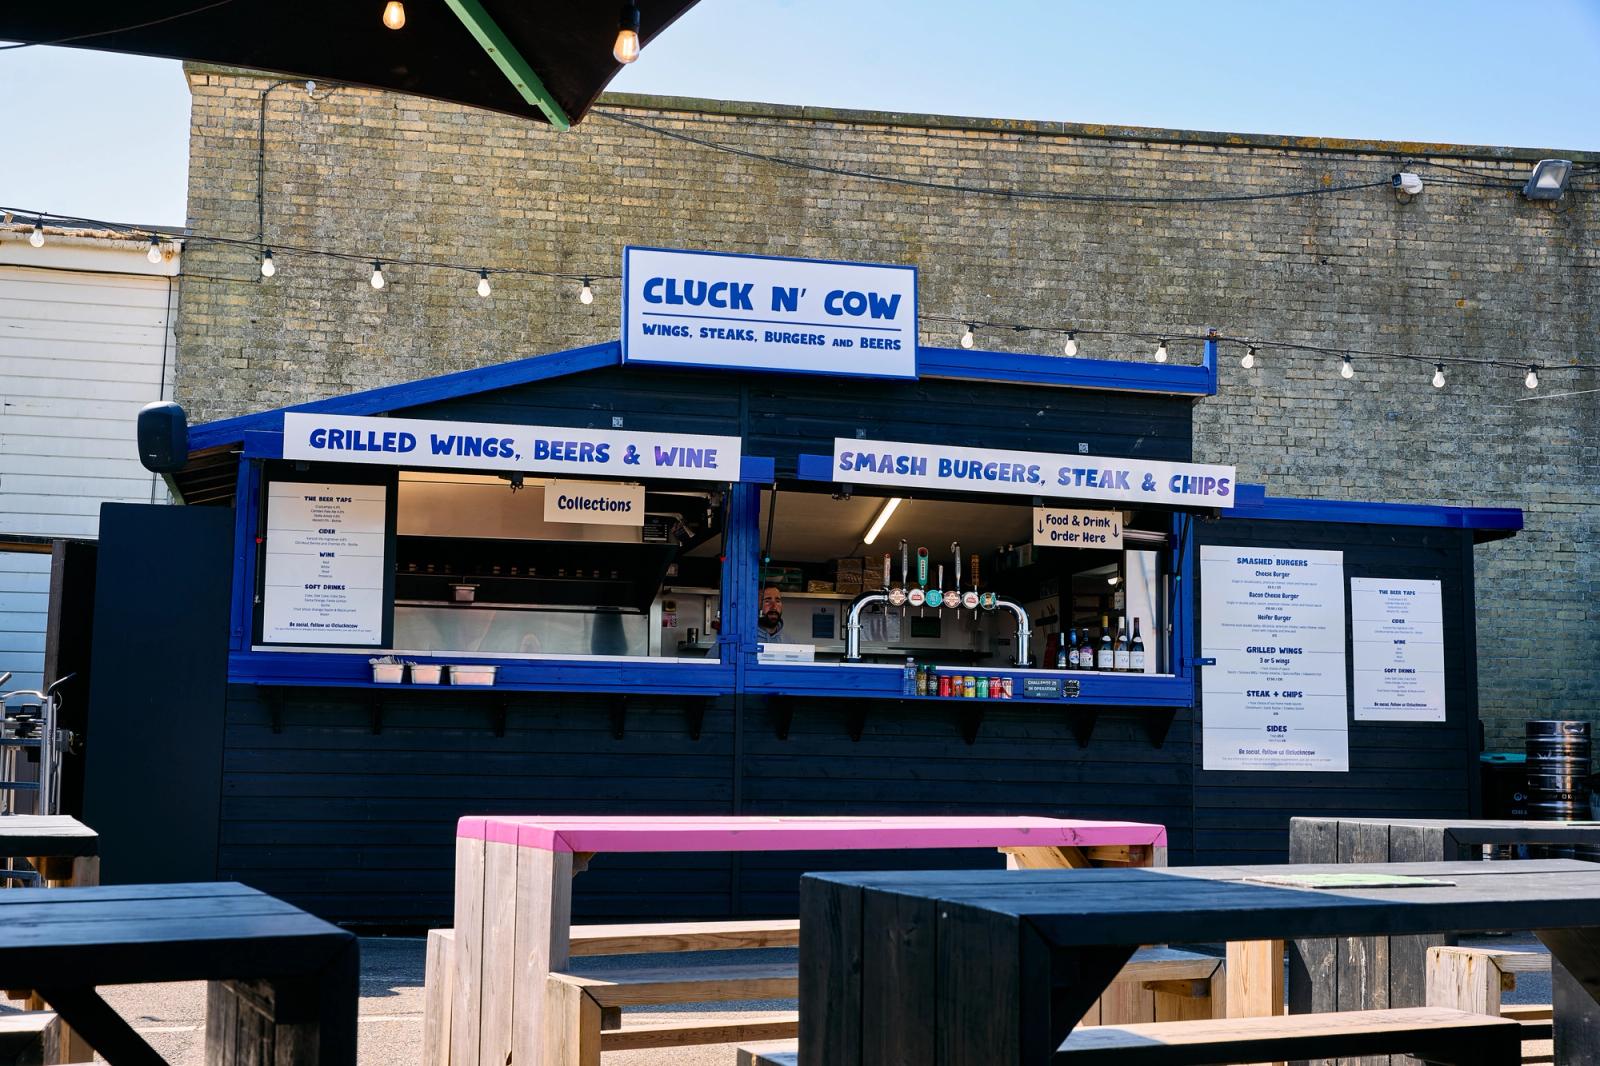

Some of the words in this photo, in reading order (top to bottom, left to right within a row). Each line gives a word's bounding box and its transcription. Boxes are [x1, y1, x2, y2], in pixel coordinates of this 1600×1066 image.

[643, 277, 754, 310] CLUCK
[771, 286, 807, 312] N'
[824, 290, 901, 320] COW
[642, 323, 692, 338] WINGS,
[700, 327, 757, 342] STEAKS,
[764, 331, 825, 345] BURGERS
[832, 338, 853, 347] AND
[860, 337, 901, 350] BEERS
[309, 428, 417, 453] GRILLED
[431, 434, 521, 460] WINGS,
[534, 439, 611, 463] BEERS
[623, 444, 641, 464] &
[654, 445, 718, 469] WINE
[839, 452, 928, 476] SMASH
[938, 458, 1046, 486] BURGERS,
[1057, 467, 1130, 490] STEAK
[1141, 473, 1156, 492] &
[1168, 474, 1230, 497] CHIPS
[558, 495, 632, 512] Collections
[1046, 514, 1068, 525] Food
[1072, 515, 1080, 526] &
[1083, 517, 1110, 527] Drink
[1051, 531, 1080, 542] Order
[1083, 532, 1106, 543] Here
